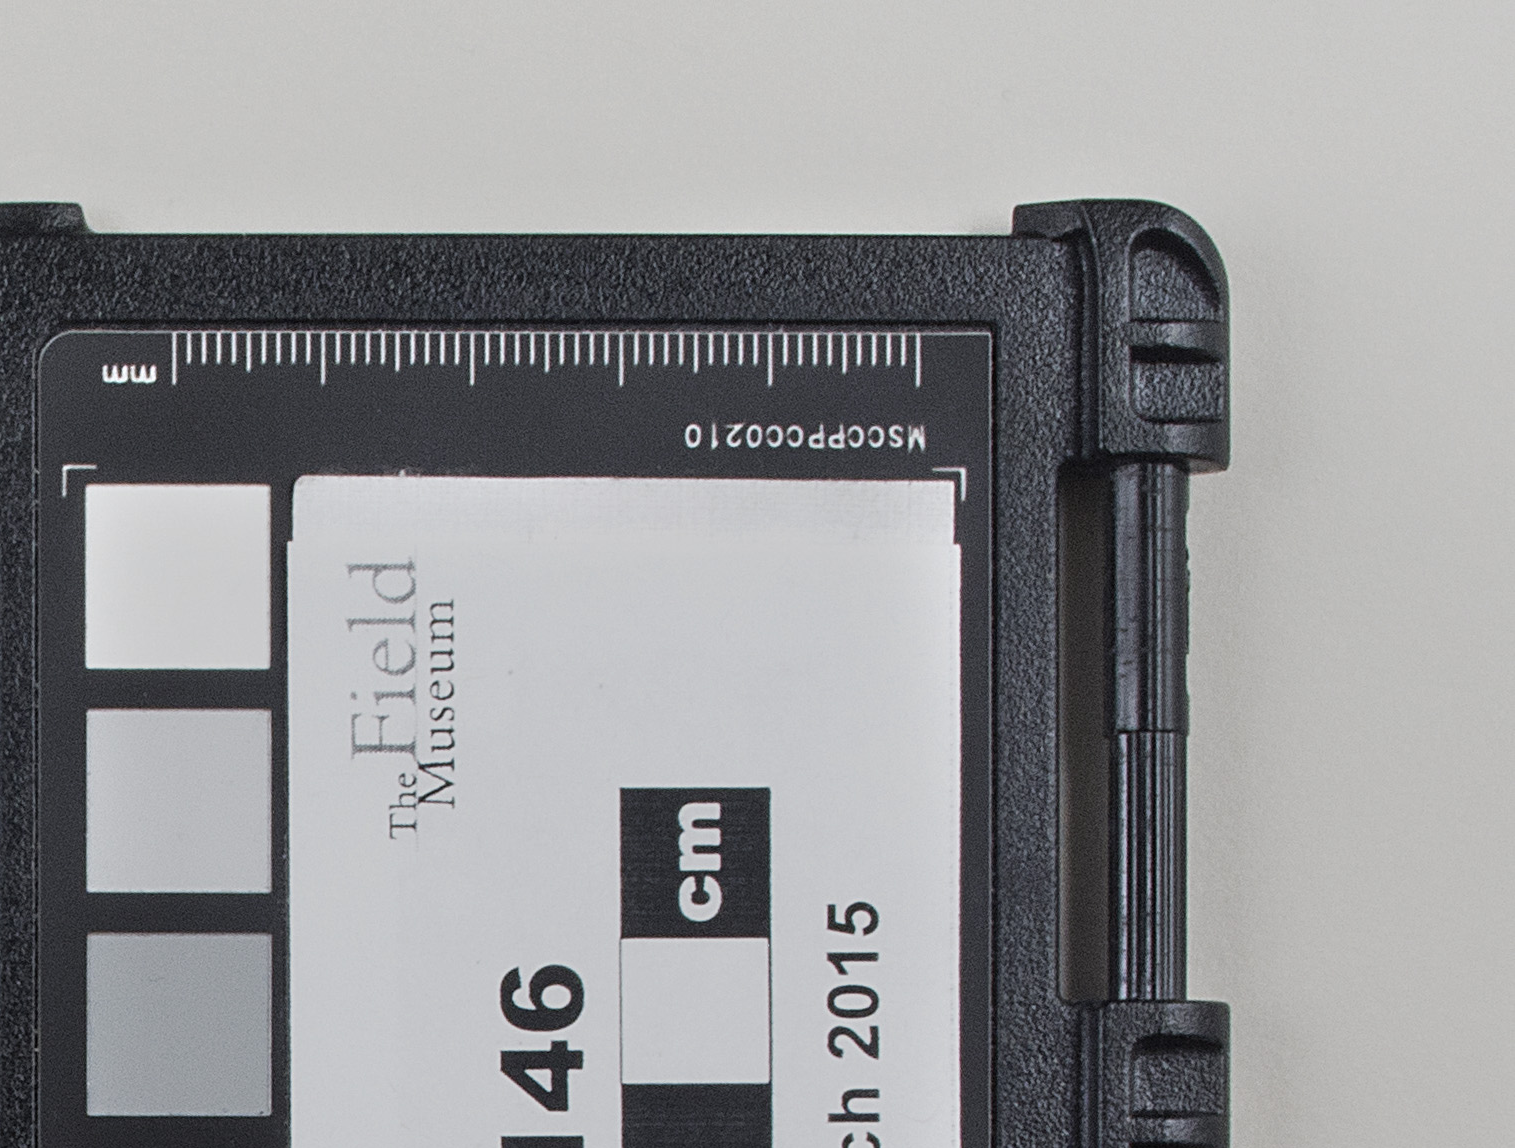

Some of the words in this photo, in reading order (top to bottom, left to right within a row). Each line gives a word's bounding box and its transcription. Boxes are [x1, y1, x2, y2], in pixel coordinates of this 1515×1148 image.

[101, 364, 157, 384] mm
[684, 423, 926, 453] MSCCPPCC0210
[345, 556, 416, 762] Field
[416, 599, 456, 809] Museum
[388, 772, 417, 840] The
[677, 802, 724, 922] cm
[826, 901, 880, 1060] 2015
